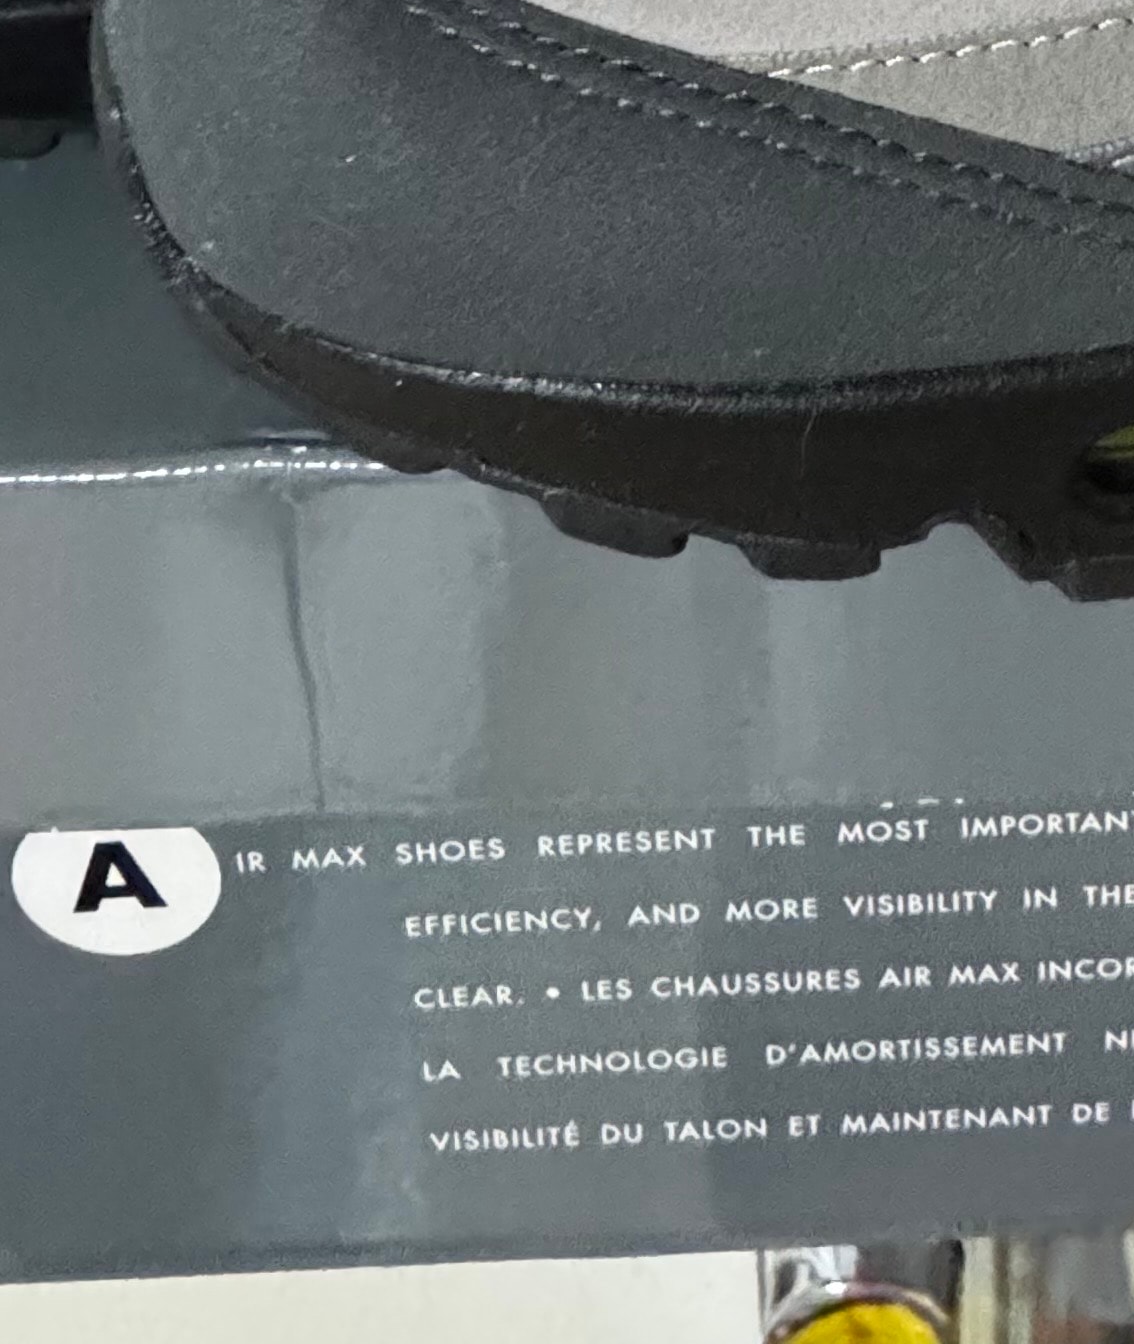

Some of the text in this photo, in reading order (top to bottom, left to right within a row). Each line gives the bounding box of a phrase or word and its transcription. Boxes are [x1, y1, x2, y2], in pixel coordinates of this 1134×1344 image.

[234, 850, 267, 875] IR
[291, 843, 367, 871] MAX
[394, 836, 506, 867] SHOES
[536, 827, 717, 859] REPRESENT
[746, 823, 806, 848] THE
[837, 818, 929, 846] MOST
[404, 906, 602, 941] EFFICIENCY,
[626, 902, 701, 929] AND
[724, 896, 819, 923] MORE
[842, 888, 999, 918] VISIBILITY
[1022, 885, 1059, 914] IN
[580, 977, 633, 1004] LES
[648, 967, 862, 1001] CHAUSSURES
[878, 965, 932, 990] AIR
[947, 961, 1021, 988] MAX
[421, 1058, 462, 1083] LA
[496, 1045, 728, 1082] TECHNOLOGIE
[764, 1031, 1068, 1070] D'AMORTISSEMENT
[428, 1118, 581, 1153] VISIBILITÉ
[599, 1122, 644, 1150] DU
[663, 1117, 768, 1144] TALON
[787, 1113, 822, 1140] ET
[839, 1103, 1054, 1136] MAINTENANT
[1070, 1100, 1111, 1126] DE
